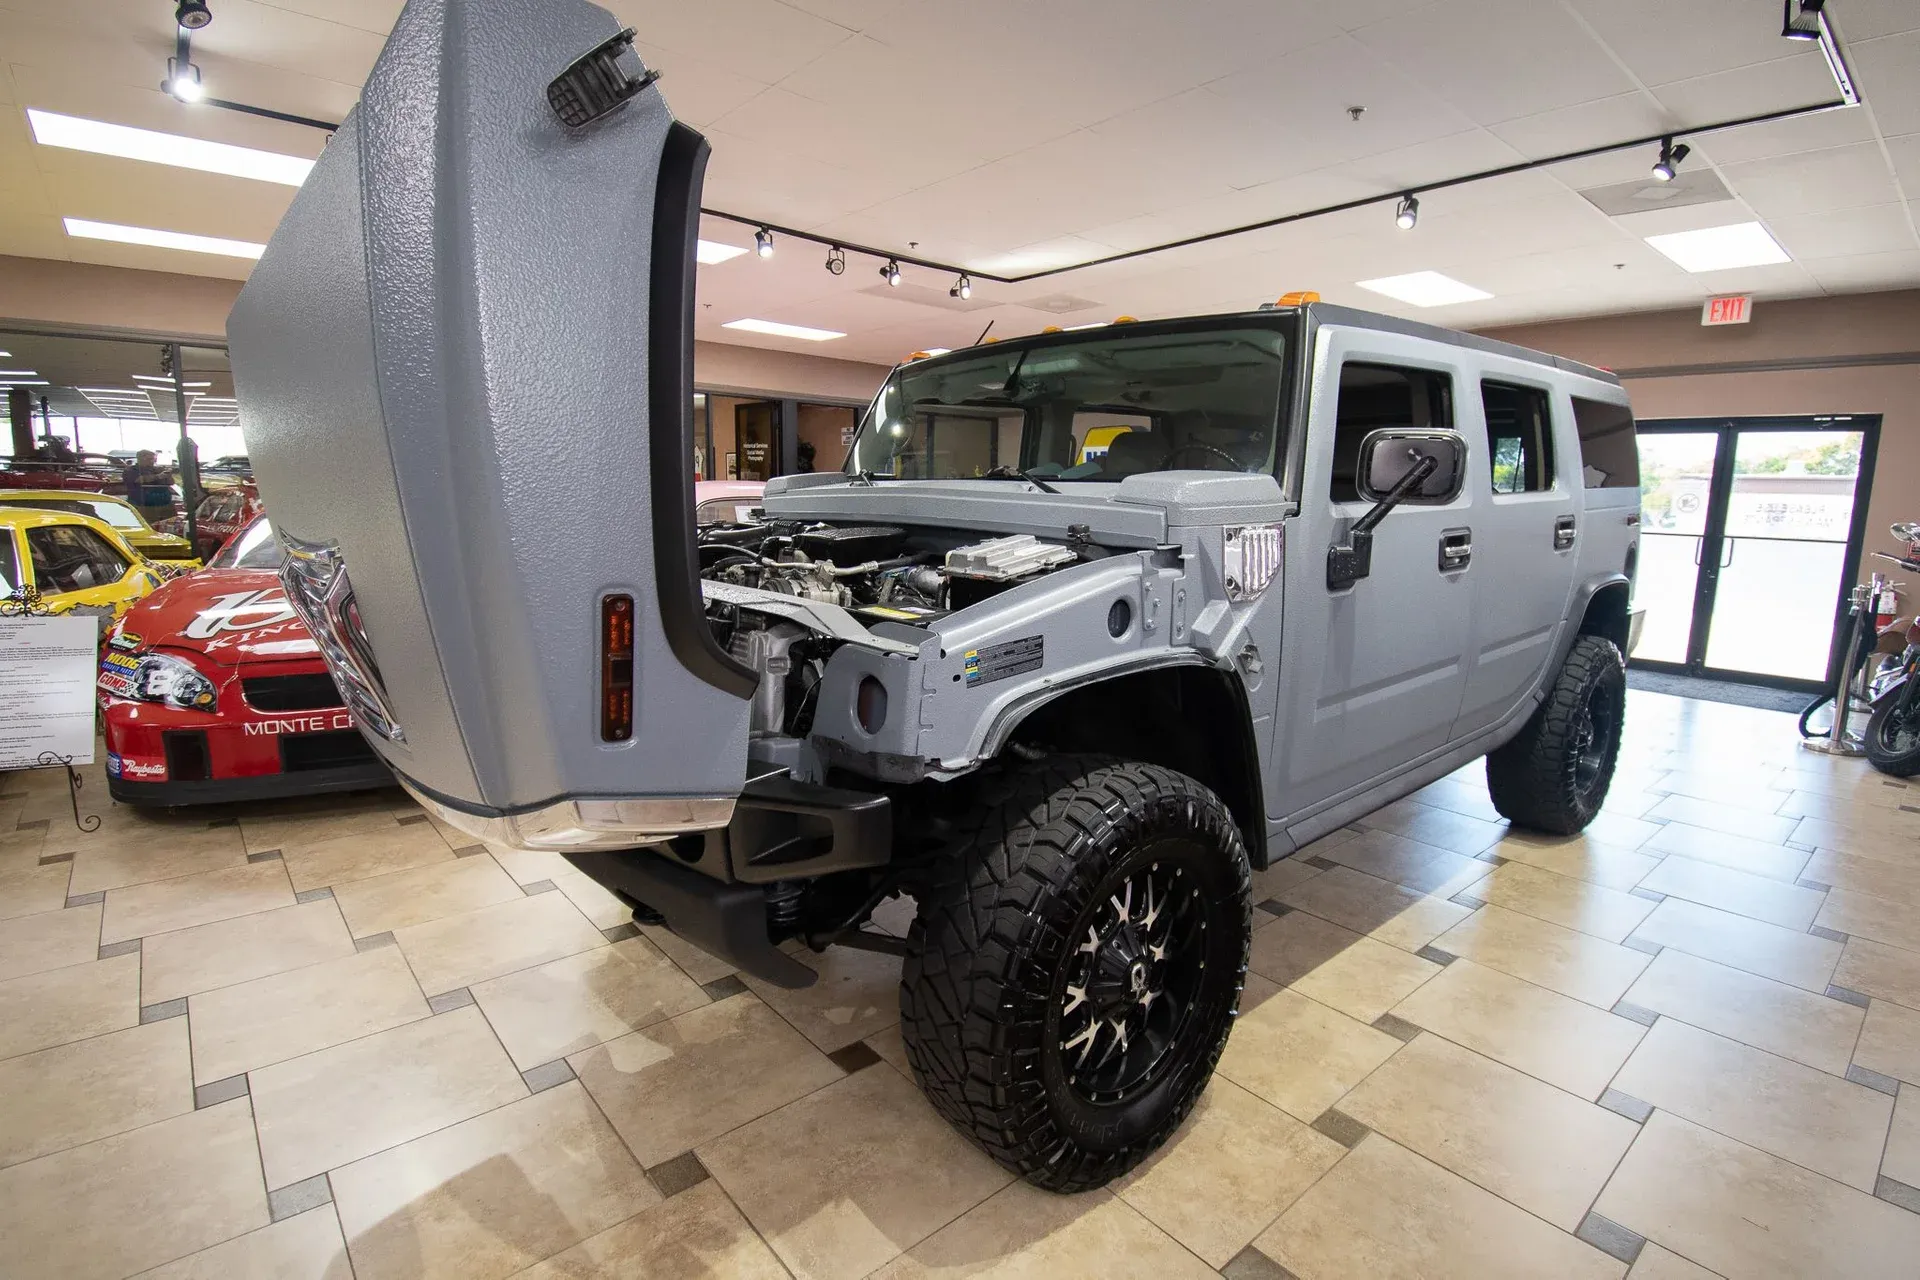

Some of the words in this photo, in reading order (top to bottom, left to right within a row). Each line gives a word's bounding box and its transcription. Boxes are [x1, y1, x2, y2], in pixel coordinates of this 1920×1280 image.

[1709, 297, 1746, 322] EXIT
[105, 652, 142, 670] MOOG
[99, 673, 127, 689] COMP
[243, 717, 324, 736] MONTE
